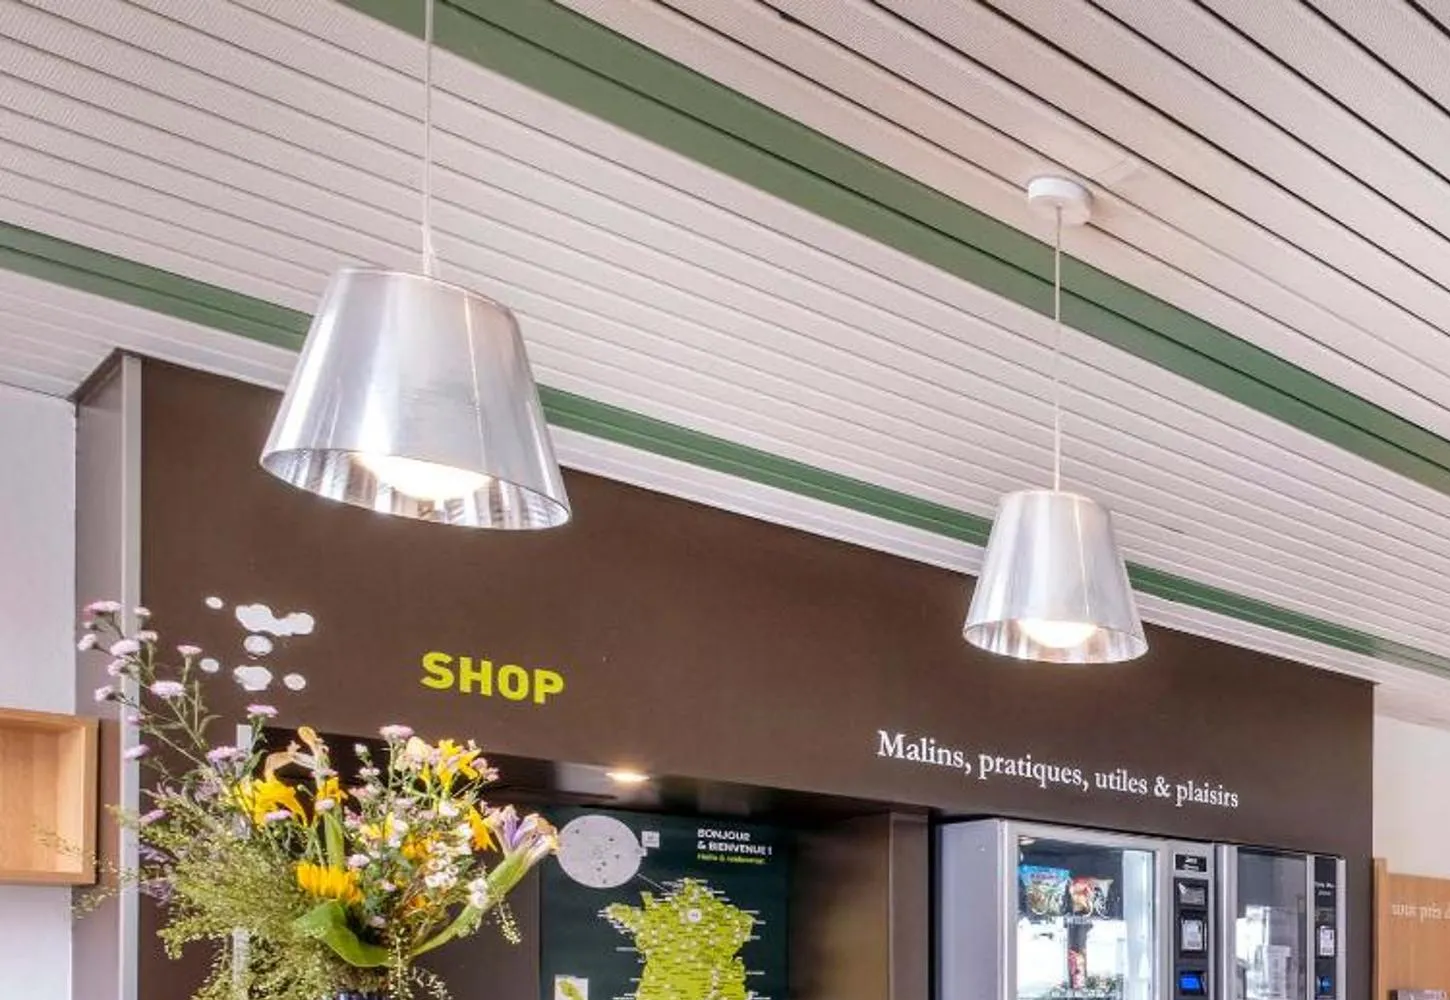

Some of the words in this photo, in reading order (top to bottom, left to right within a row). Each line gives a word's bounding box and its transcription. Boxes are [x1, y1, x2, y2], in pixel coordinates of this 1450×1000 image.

[420, 651, 564, 704] SHOP
[877, 730, 971, 775] Malins,
[978, 752, 1089, 792] pratiques,
[1095, 768, 1148, 796] utiles
[1154, 776, 1171, 798] &
[1175, 780, 1239, 808] plaisirs
[697, 828, 750, 841] BONJOUR
